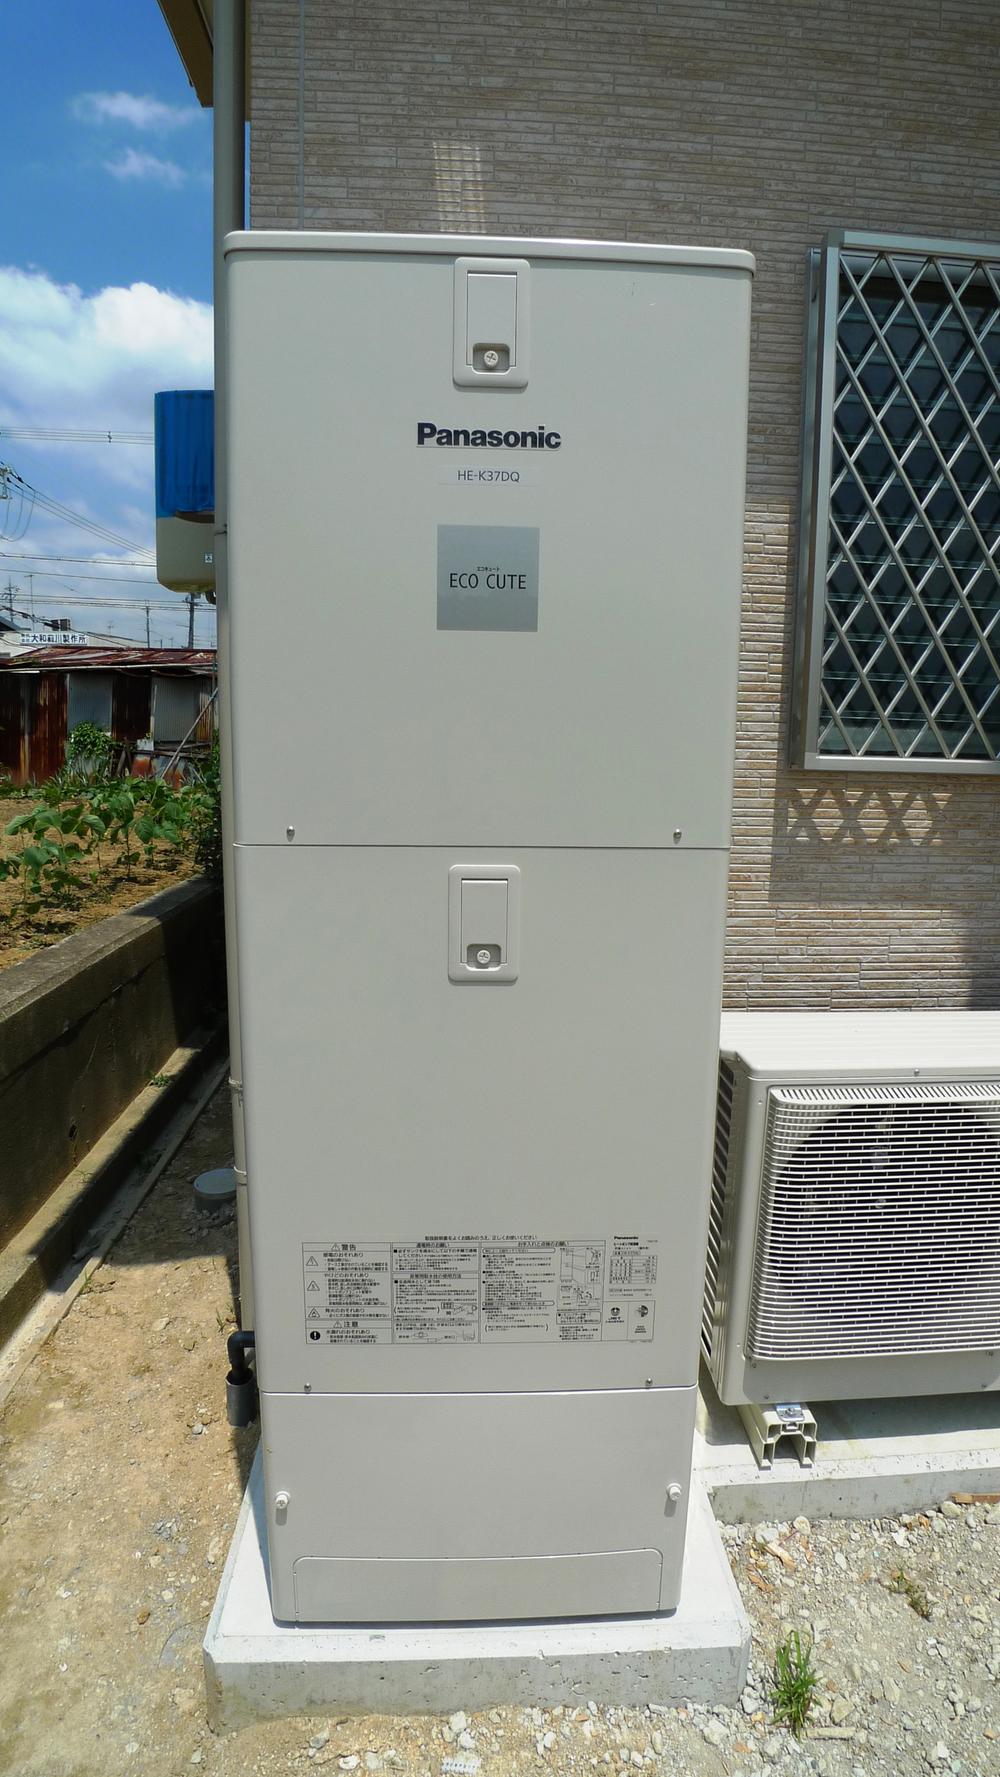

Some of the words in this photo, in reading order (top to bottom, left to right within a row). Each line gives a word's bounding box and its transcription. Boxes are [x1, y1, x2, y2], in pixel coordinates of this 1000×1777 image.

[417, 422, 561, 449] Panasonic
[457, 470, 520, 482] HE-K37DQ
[450, 573, 479, 589] ECO
[486, 574, 527, 590] CUTE
